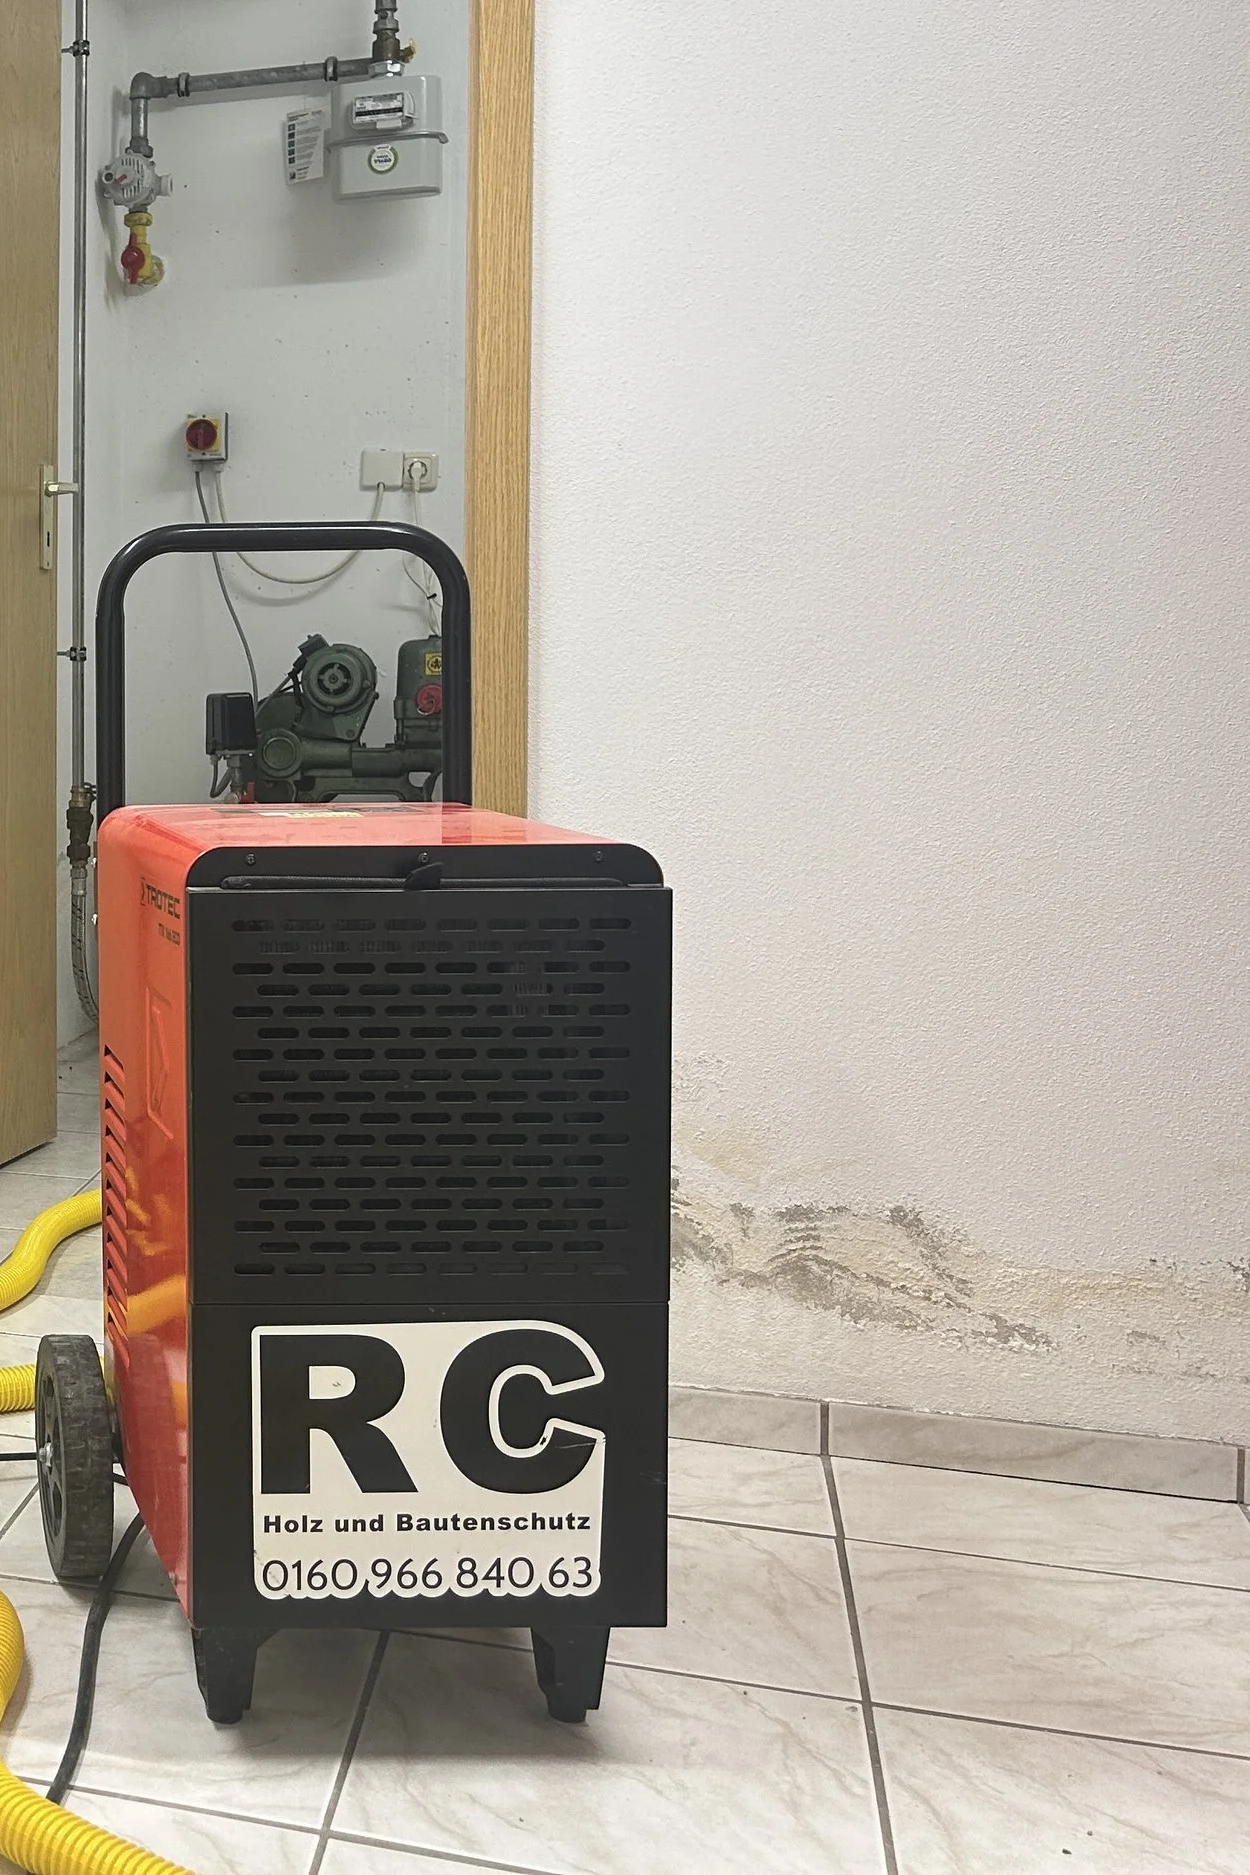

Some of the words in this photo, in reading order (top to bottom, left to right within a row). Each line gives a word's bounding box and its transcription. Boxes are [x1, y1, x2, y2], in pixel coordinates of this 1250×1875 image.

[145, 884, 181, 919] TROTEC
[260, 1328, 597, 1494] RC
[263, 1515, 324, 1533] Holz
[334, 1514, 384, 1532] und
[396, 1512, 592, 1532] Bautenschutz
[262, 1558, 358, 1591] 0160
[370, 1557, 443, 1590] 966
[456, 1556, 535, 1589] 840
[548, 1556, 593, 1589] 63
